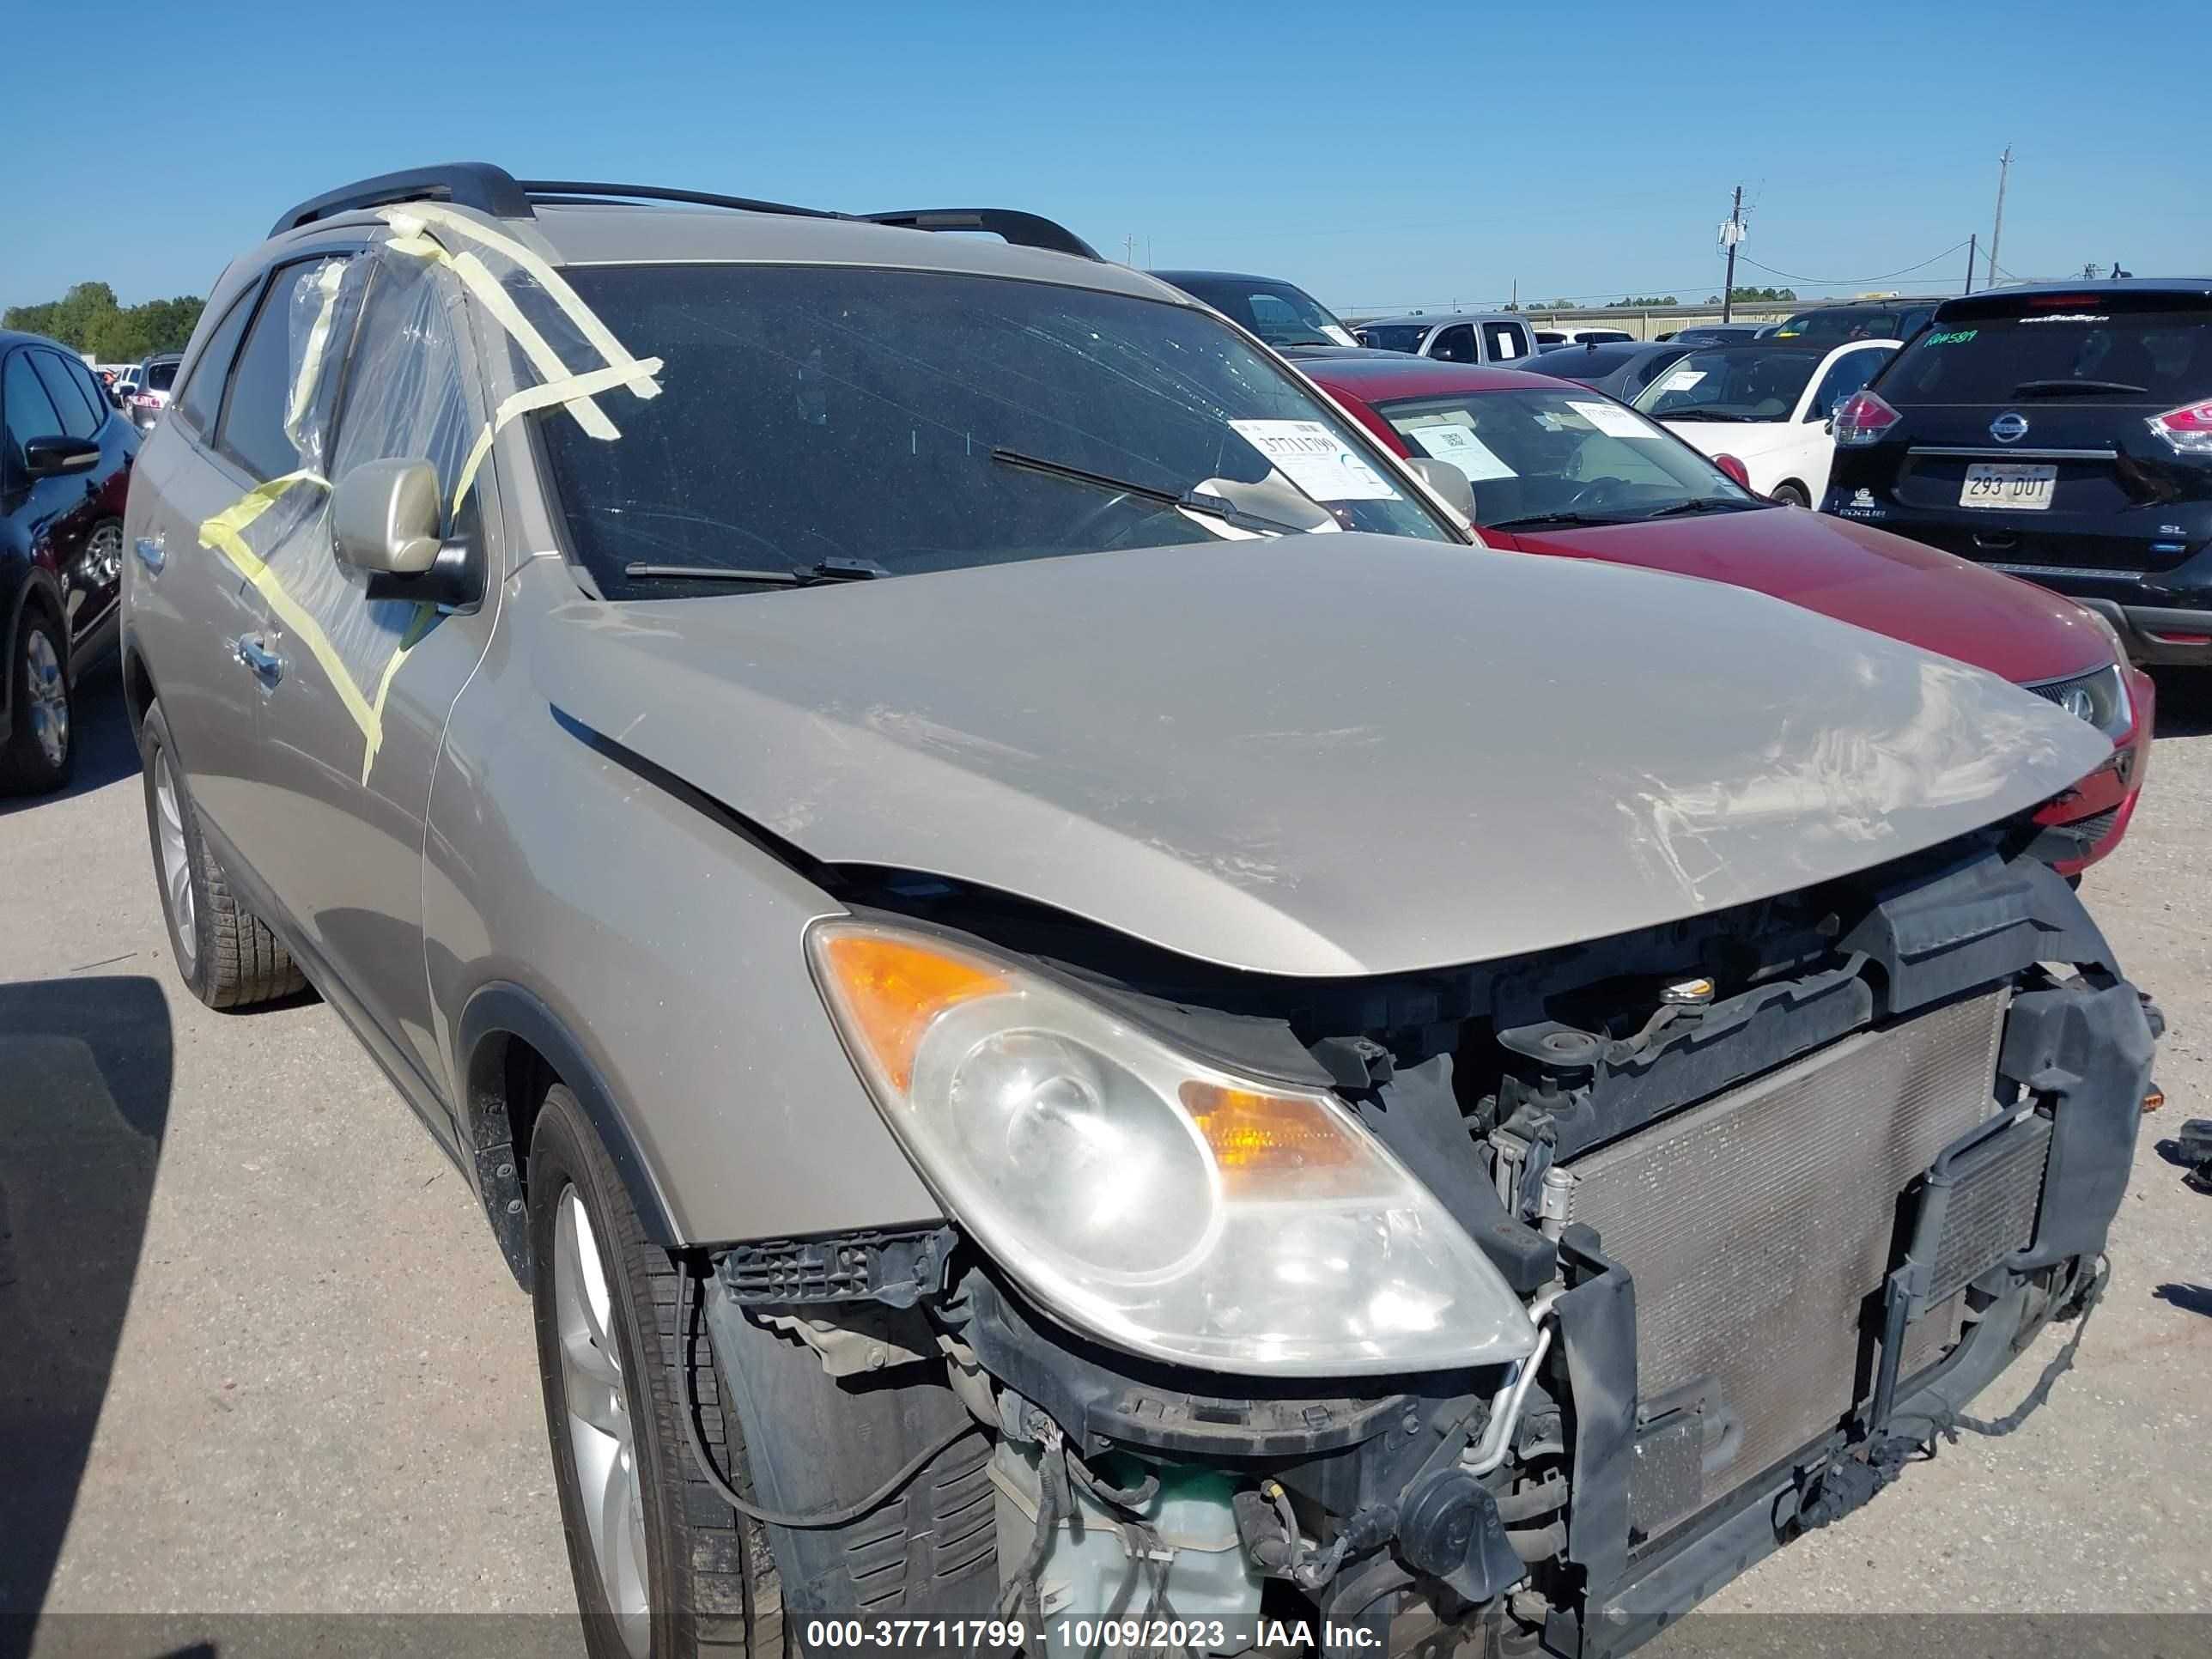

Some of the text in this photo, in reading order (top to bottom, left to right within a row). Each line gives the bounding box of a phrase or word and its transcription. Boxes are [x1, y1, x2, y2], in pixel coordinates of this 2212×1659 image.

[1259, 437, 1338, 453] 37711799
[1970, 477, 2048, 496] 293 DUT
[2160, 525, 2187, 534] SL
